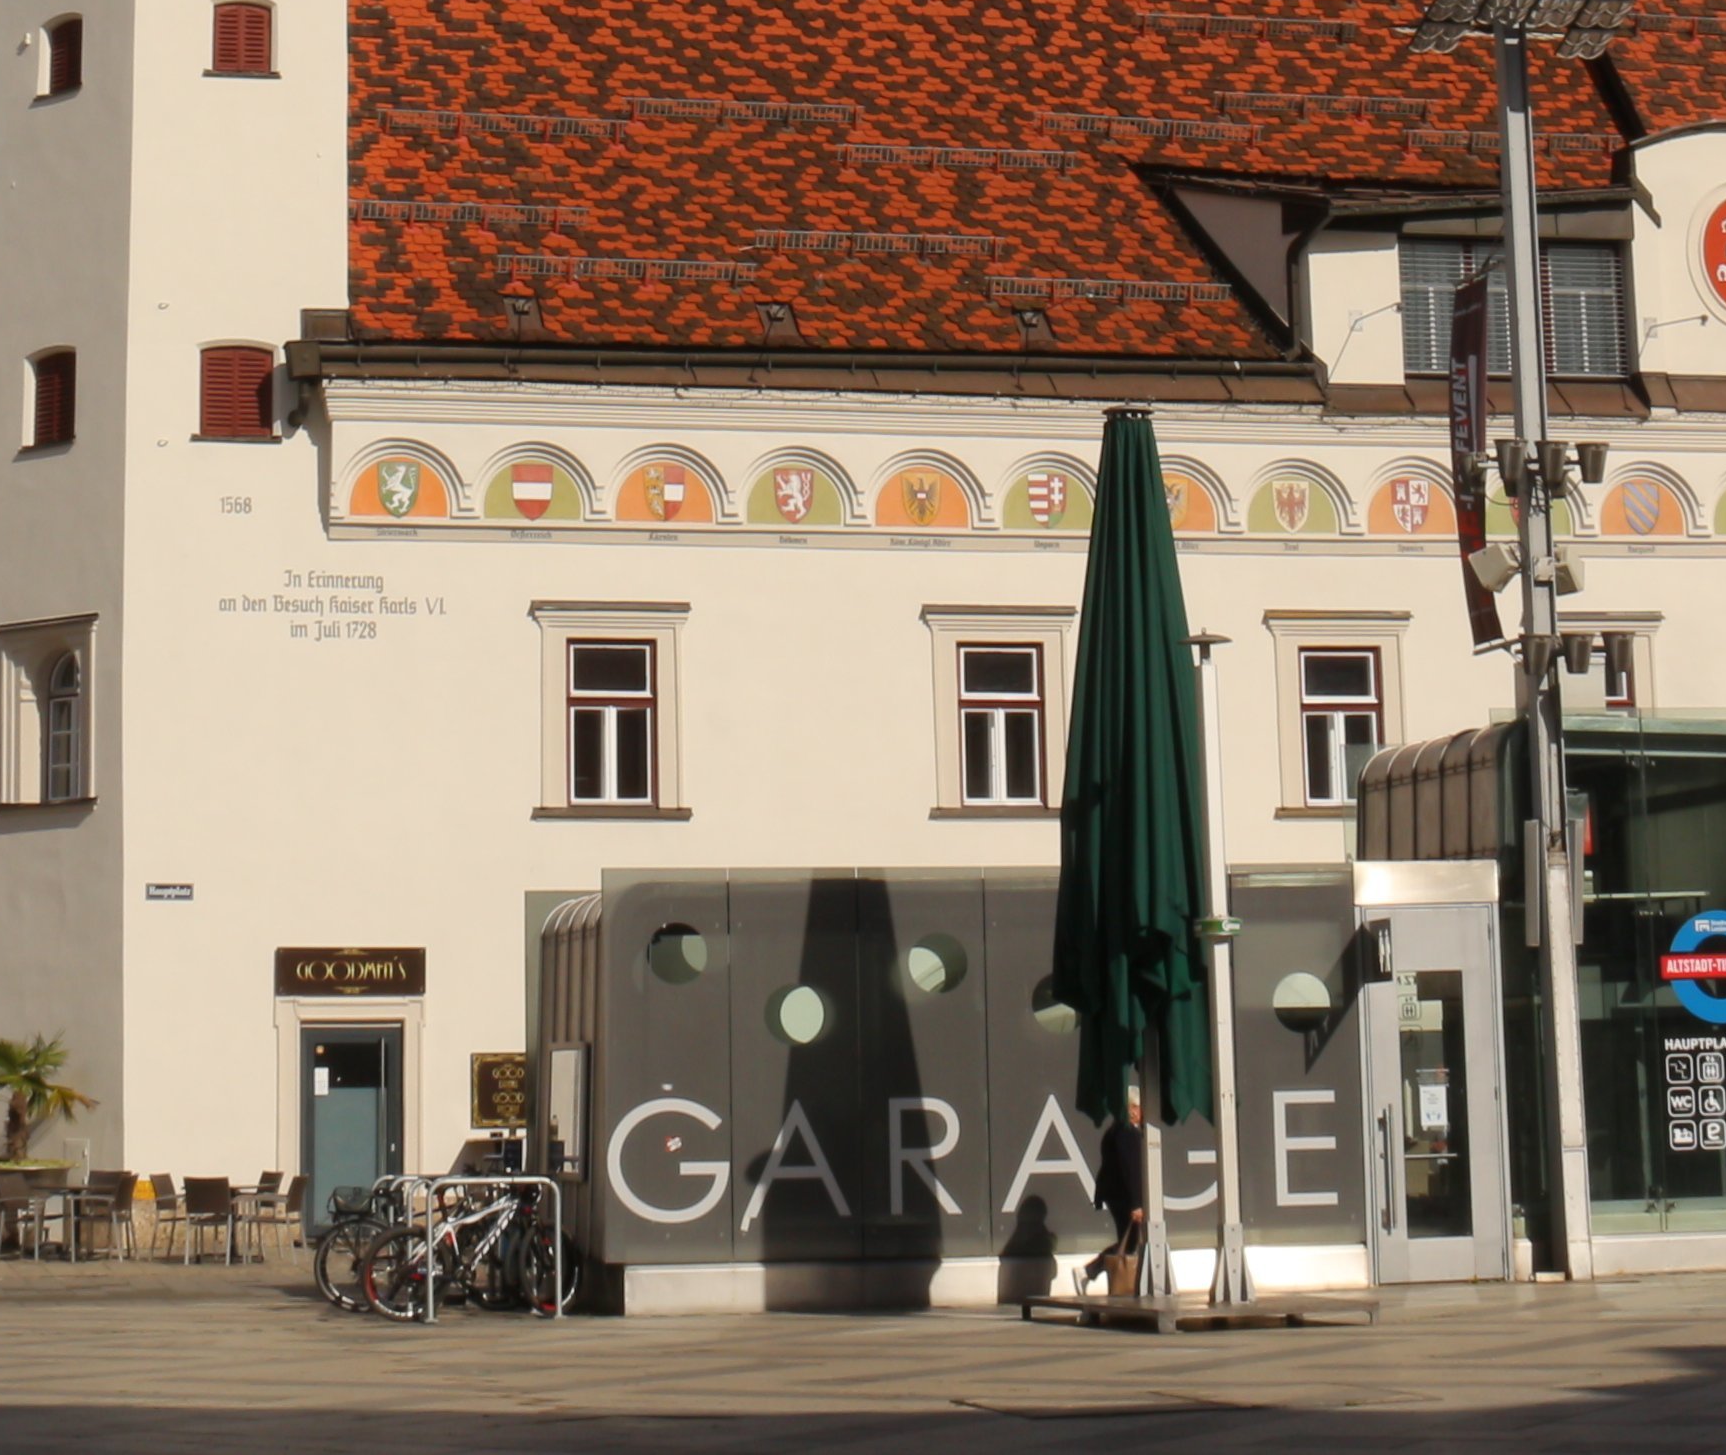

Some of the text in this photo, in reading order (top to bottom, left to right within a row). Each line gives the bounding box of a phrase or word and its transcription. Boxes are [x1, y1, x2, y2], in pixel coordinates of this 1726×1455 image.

[220, 496, 253, 514] 1568
[283, 570, 384, 593] In Erinnerung
[219, 597, 237, 612] an
[242, 595, 267, 613] den
[273, 595, 324, 616] Besuch
[329, 596, 375, 615] Kaiser
[379, 596, 417, 615] Karls
[290, 620, 377, 641] im Juli 1728
[1670, 1095, 1693, 1109] WC
